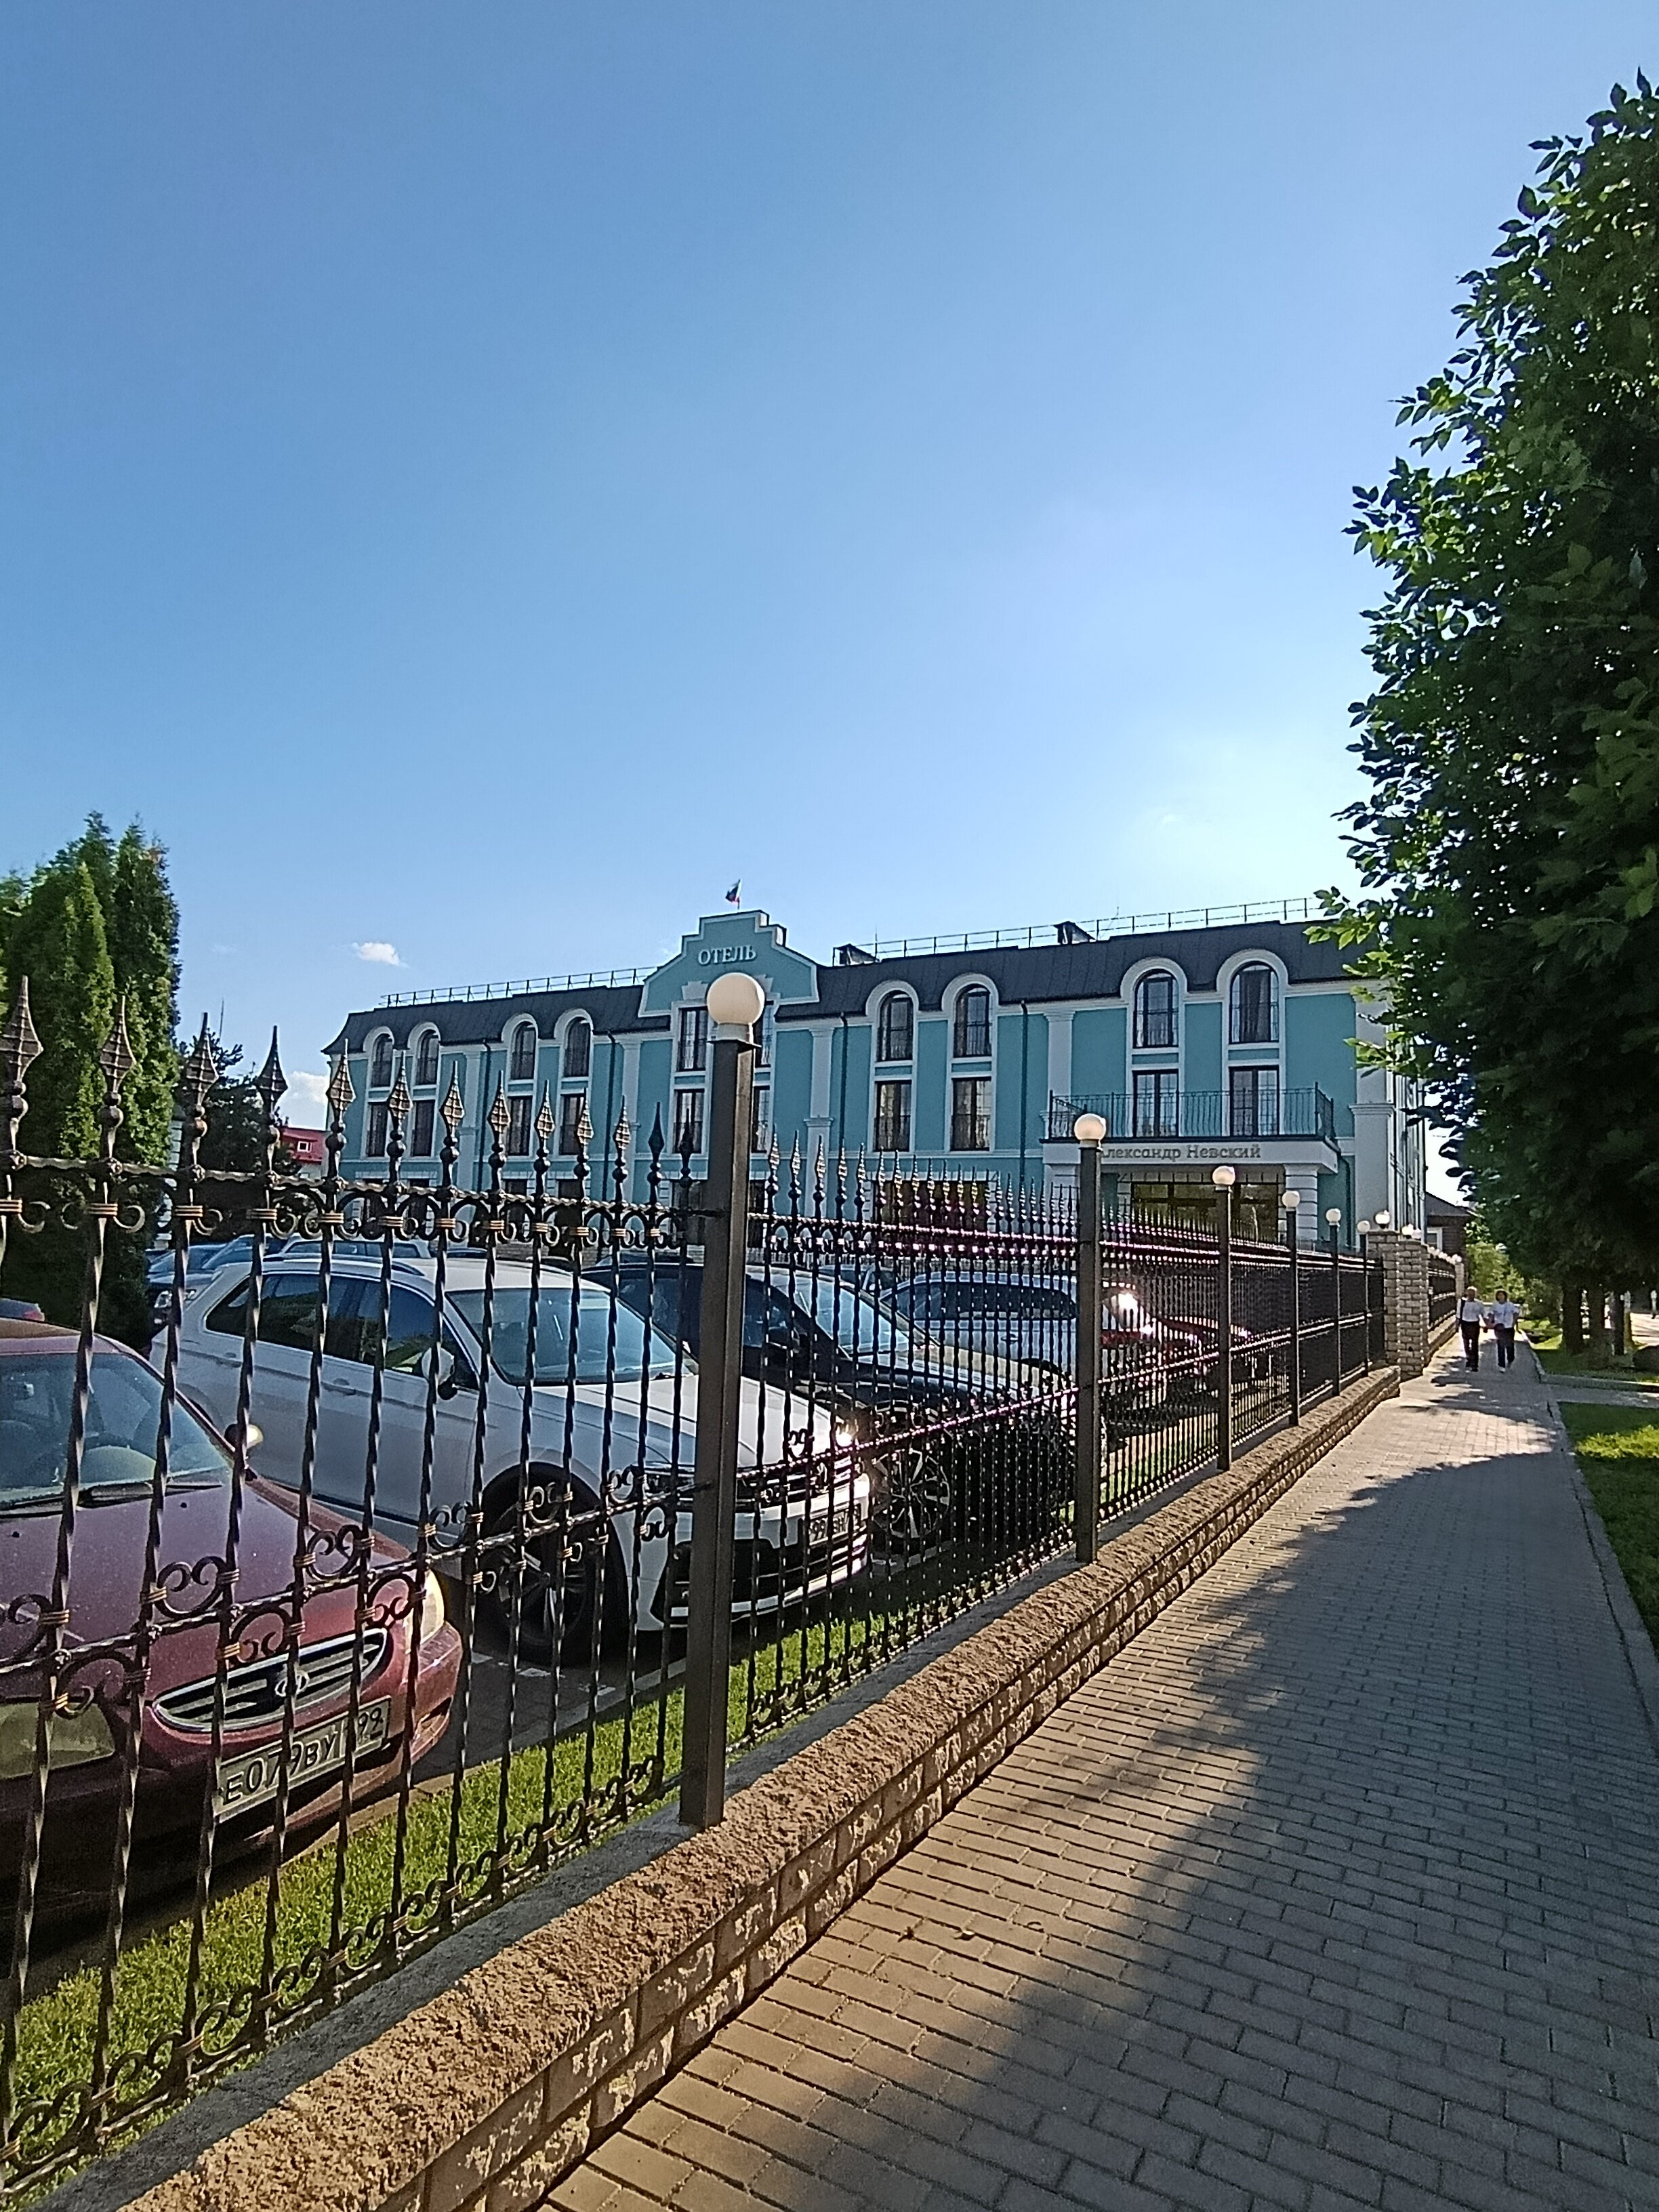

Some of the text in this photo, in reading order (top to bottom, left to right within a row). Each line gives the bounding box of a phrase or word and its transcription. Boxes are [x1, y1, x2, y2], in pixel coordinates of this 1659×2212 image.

[698, 945, 756, 965] ОТЕЛЬ
[1103, 1143, 1261, 1162] лександр Невский
